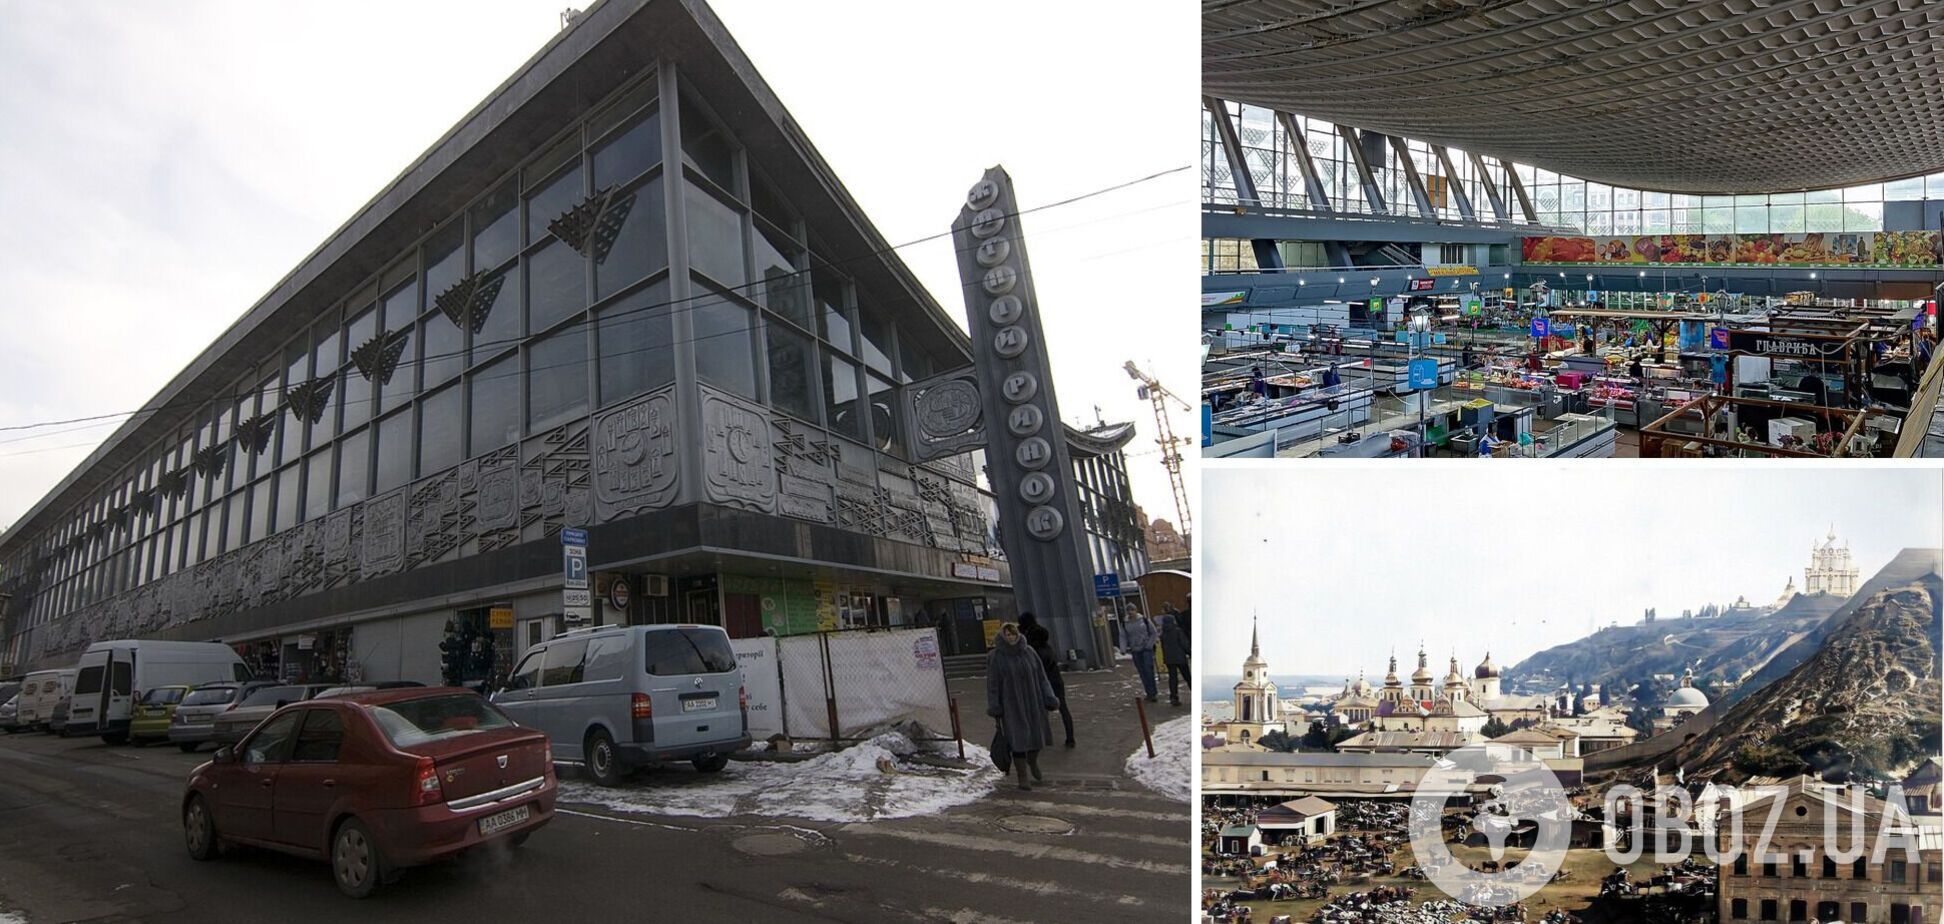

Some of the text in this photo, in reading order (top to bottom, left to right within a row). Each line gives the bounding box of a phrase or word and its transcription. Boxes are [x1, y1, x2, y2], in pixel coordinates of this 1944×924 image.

[1008, 375, 1054, 534] РИНОК
[571, 558, 583, 579] P
[1102, 575, 1110, 584] P
